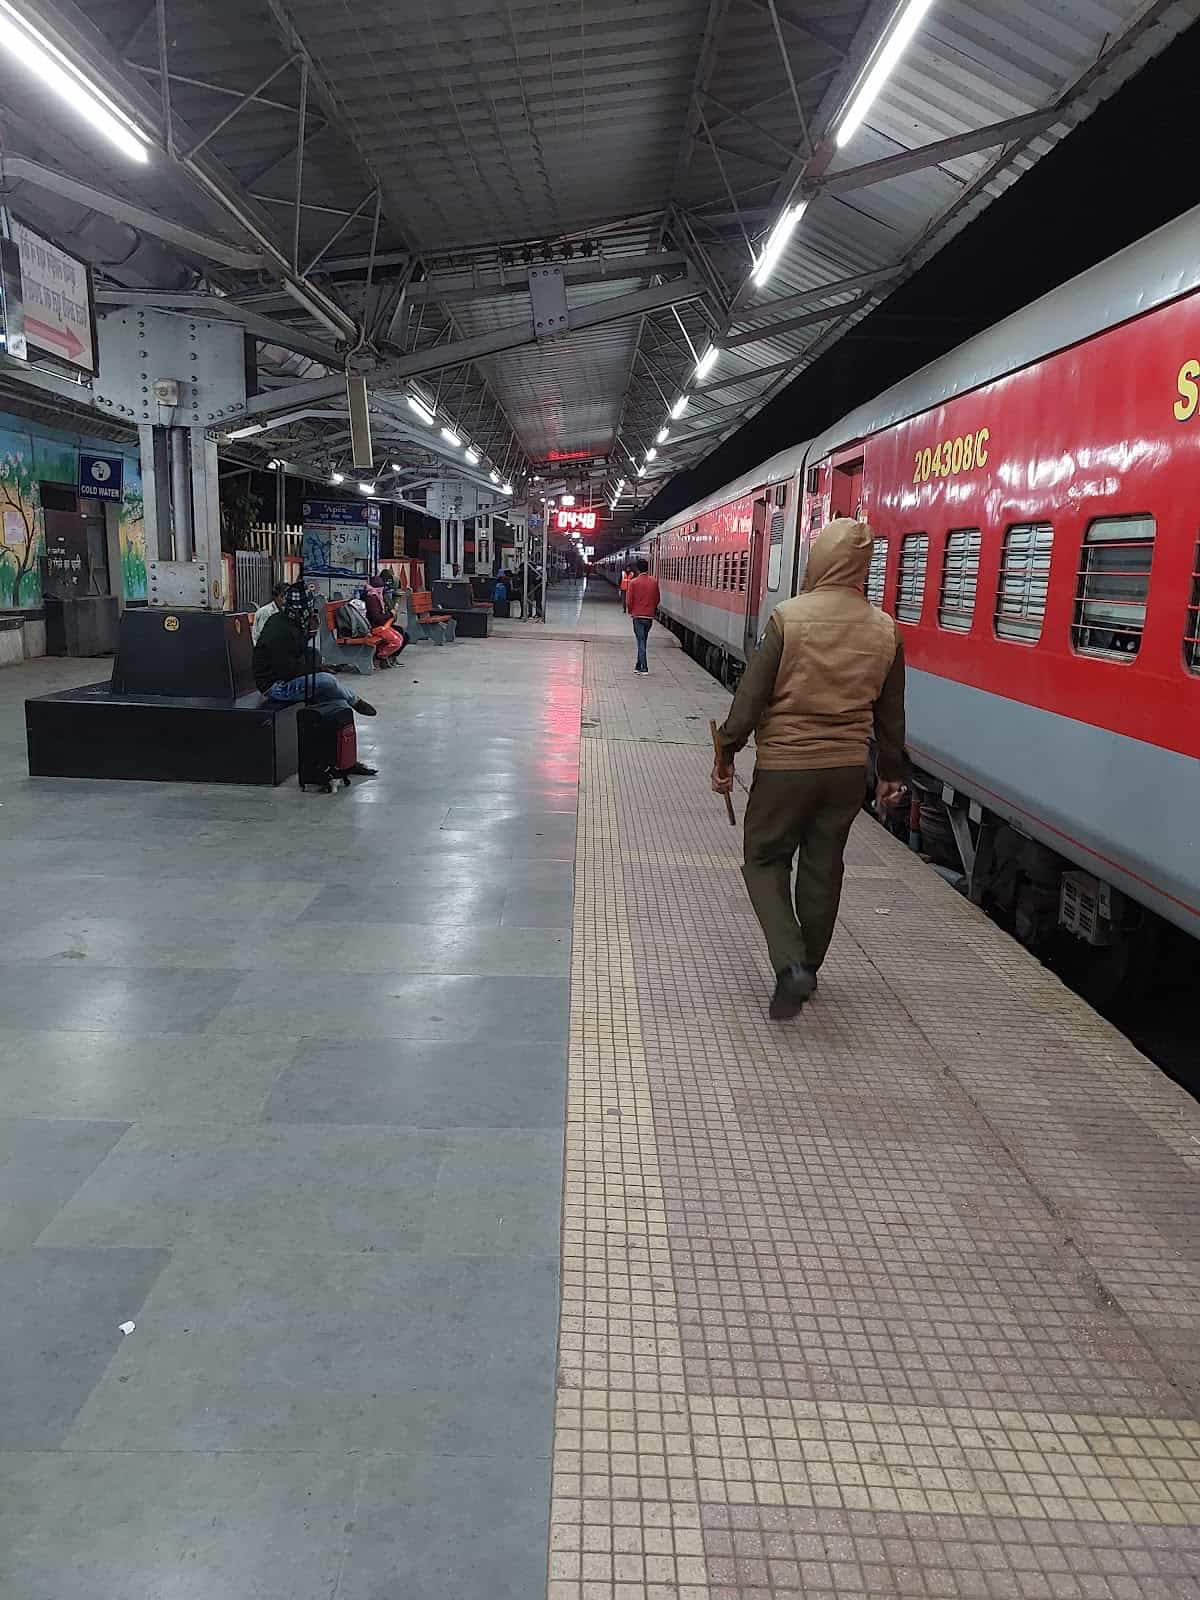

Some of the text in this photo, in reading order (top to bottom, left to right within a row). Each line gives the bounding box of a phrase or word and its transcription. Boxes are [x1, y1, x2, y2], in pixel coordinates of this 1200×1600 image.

[1173, 359, 1200, 421] S
[912, 428, 990, 484] 204308/C
[81, 484, 119, 498] COLD WATER
